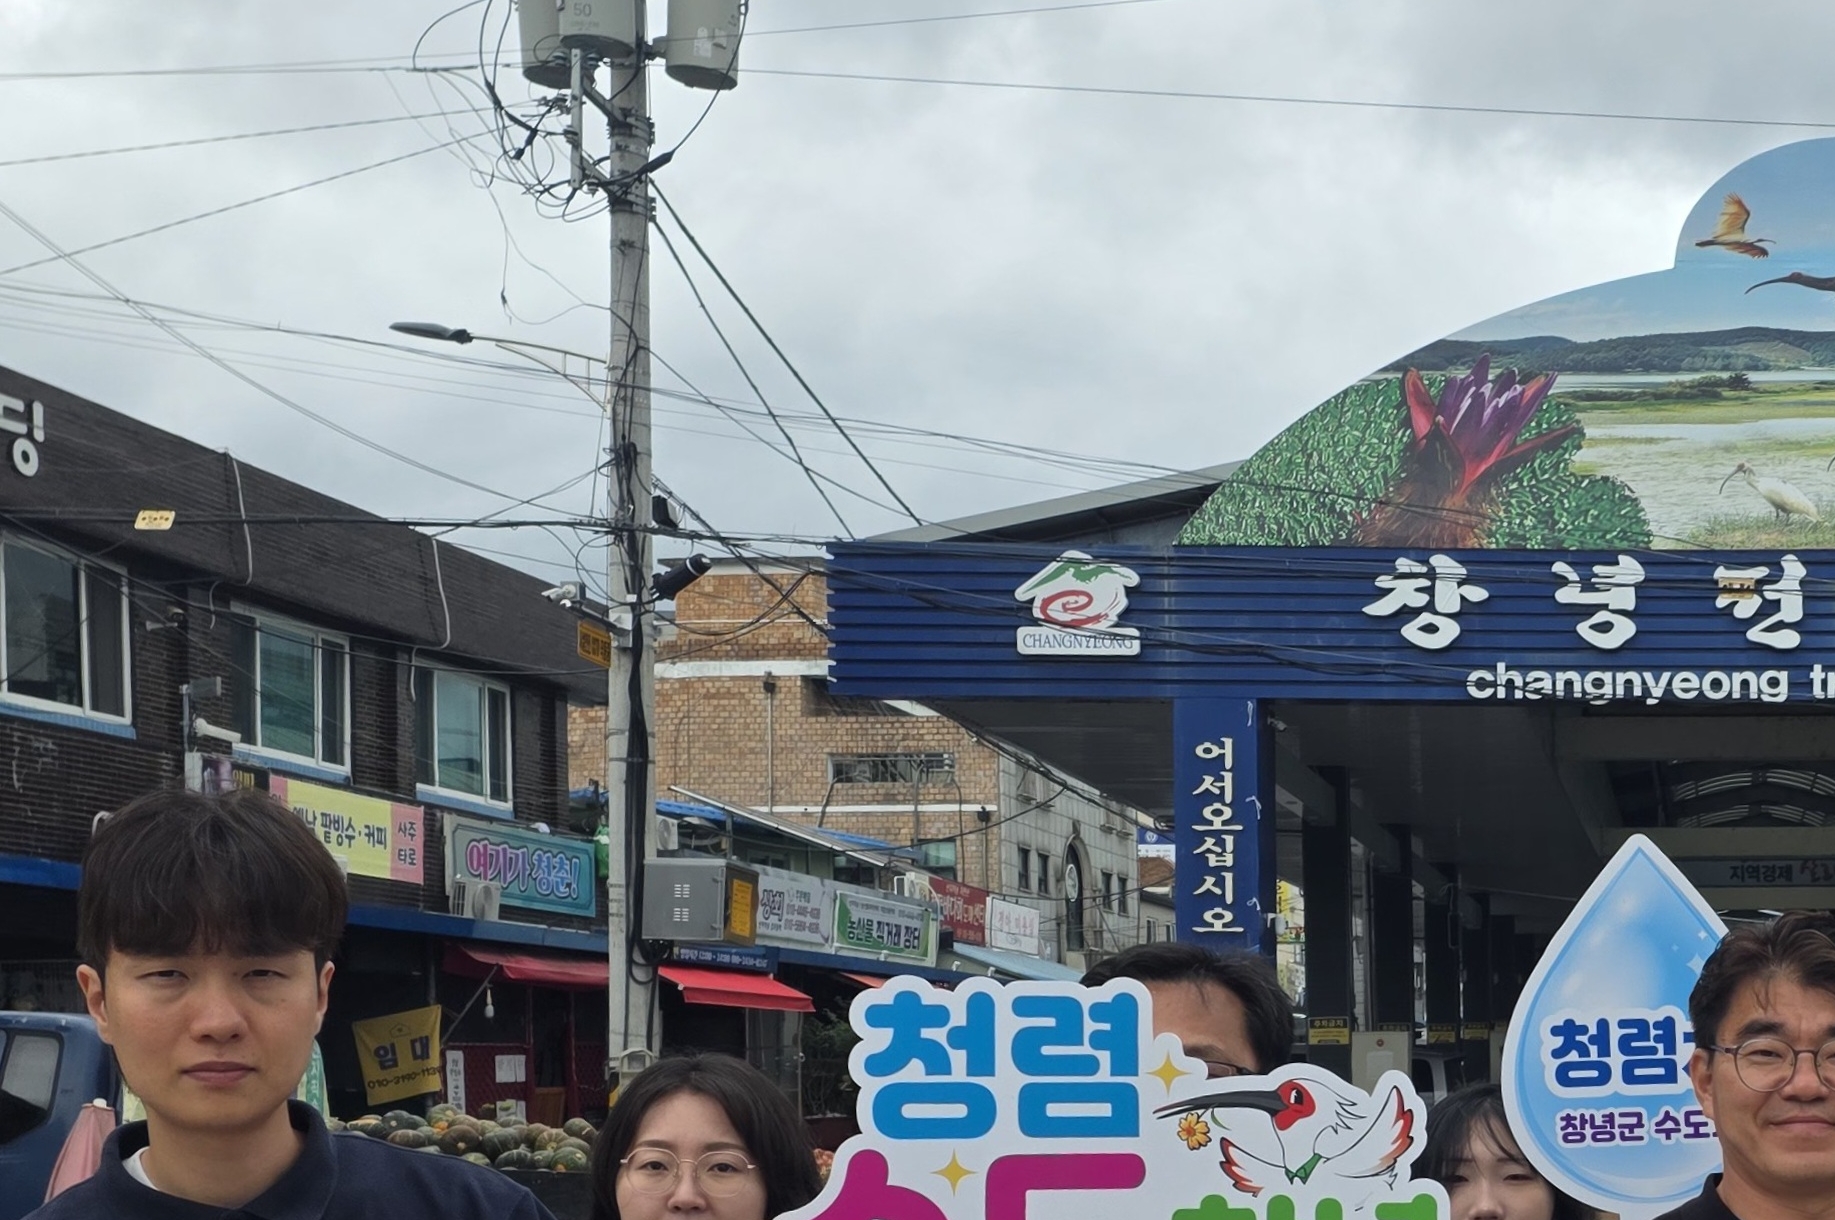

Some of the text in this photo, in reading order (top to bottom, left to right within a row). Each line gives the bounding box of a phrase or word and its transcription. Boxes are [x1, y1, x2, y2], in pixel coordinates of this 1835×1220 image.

[1022, 633, 1134, 649] CHANGNYEONG
[1466, 662, 1789, 705] changnyeong
[397, 820, 416, 842] 사주
[1192, 737, 1244, 932] 어서오십시오
[397, 847, 416, 866] 타로
[467, 840, 530, 891] 여기가
[1730, 864, 1793, 882] 지역경제
[864, 991, 1139, 1139] 청렴
[1550, 1015, 1696, 1088] 청렴
[1560, 1109, 1719, 1144] 창녕군 수도
